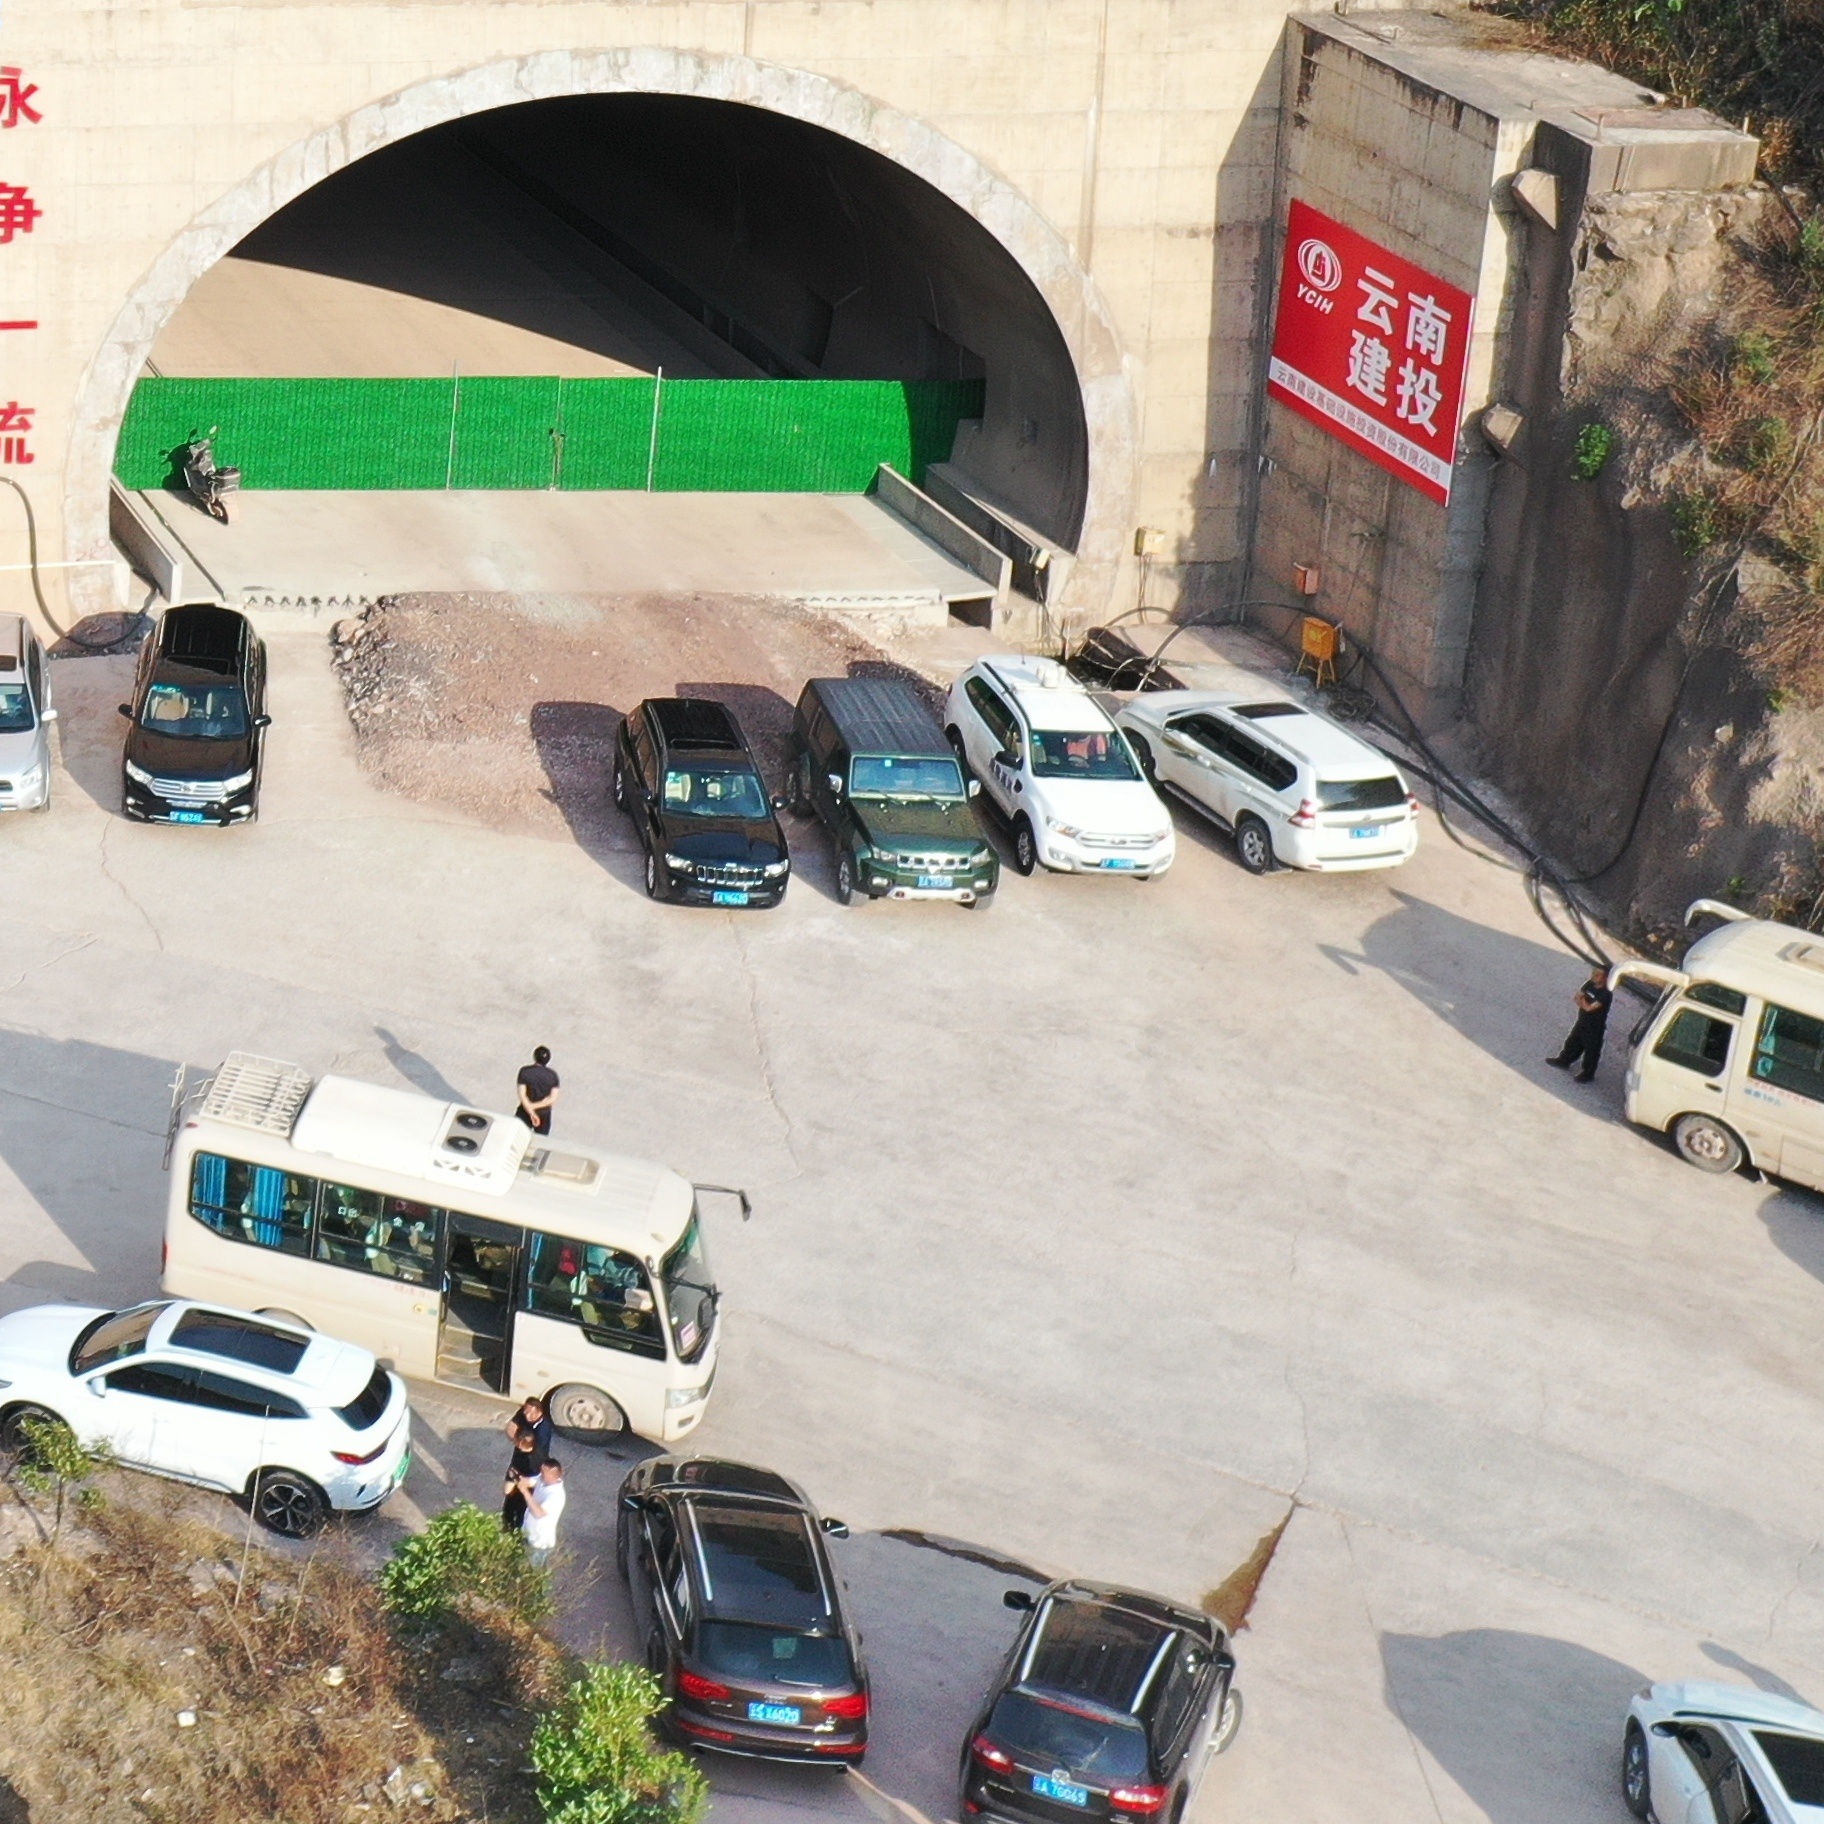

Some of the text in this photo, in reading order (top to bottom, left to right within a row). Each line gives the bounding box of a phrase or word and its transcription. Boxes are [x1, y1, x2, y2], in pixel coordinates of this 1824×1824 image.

[1297, 283, 1334, 314] YCIH
[1357, 266, 1452, 366] 云南
[1346, 329, 1443, 438] 建投
